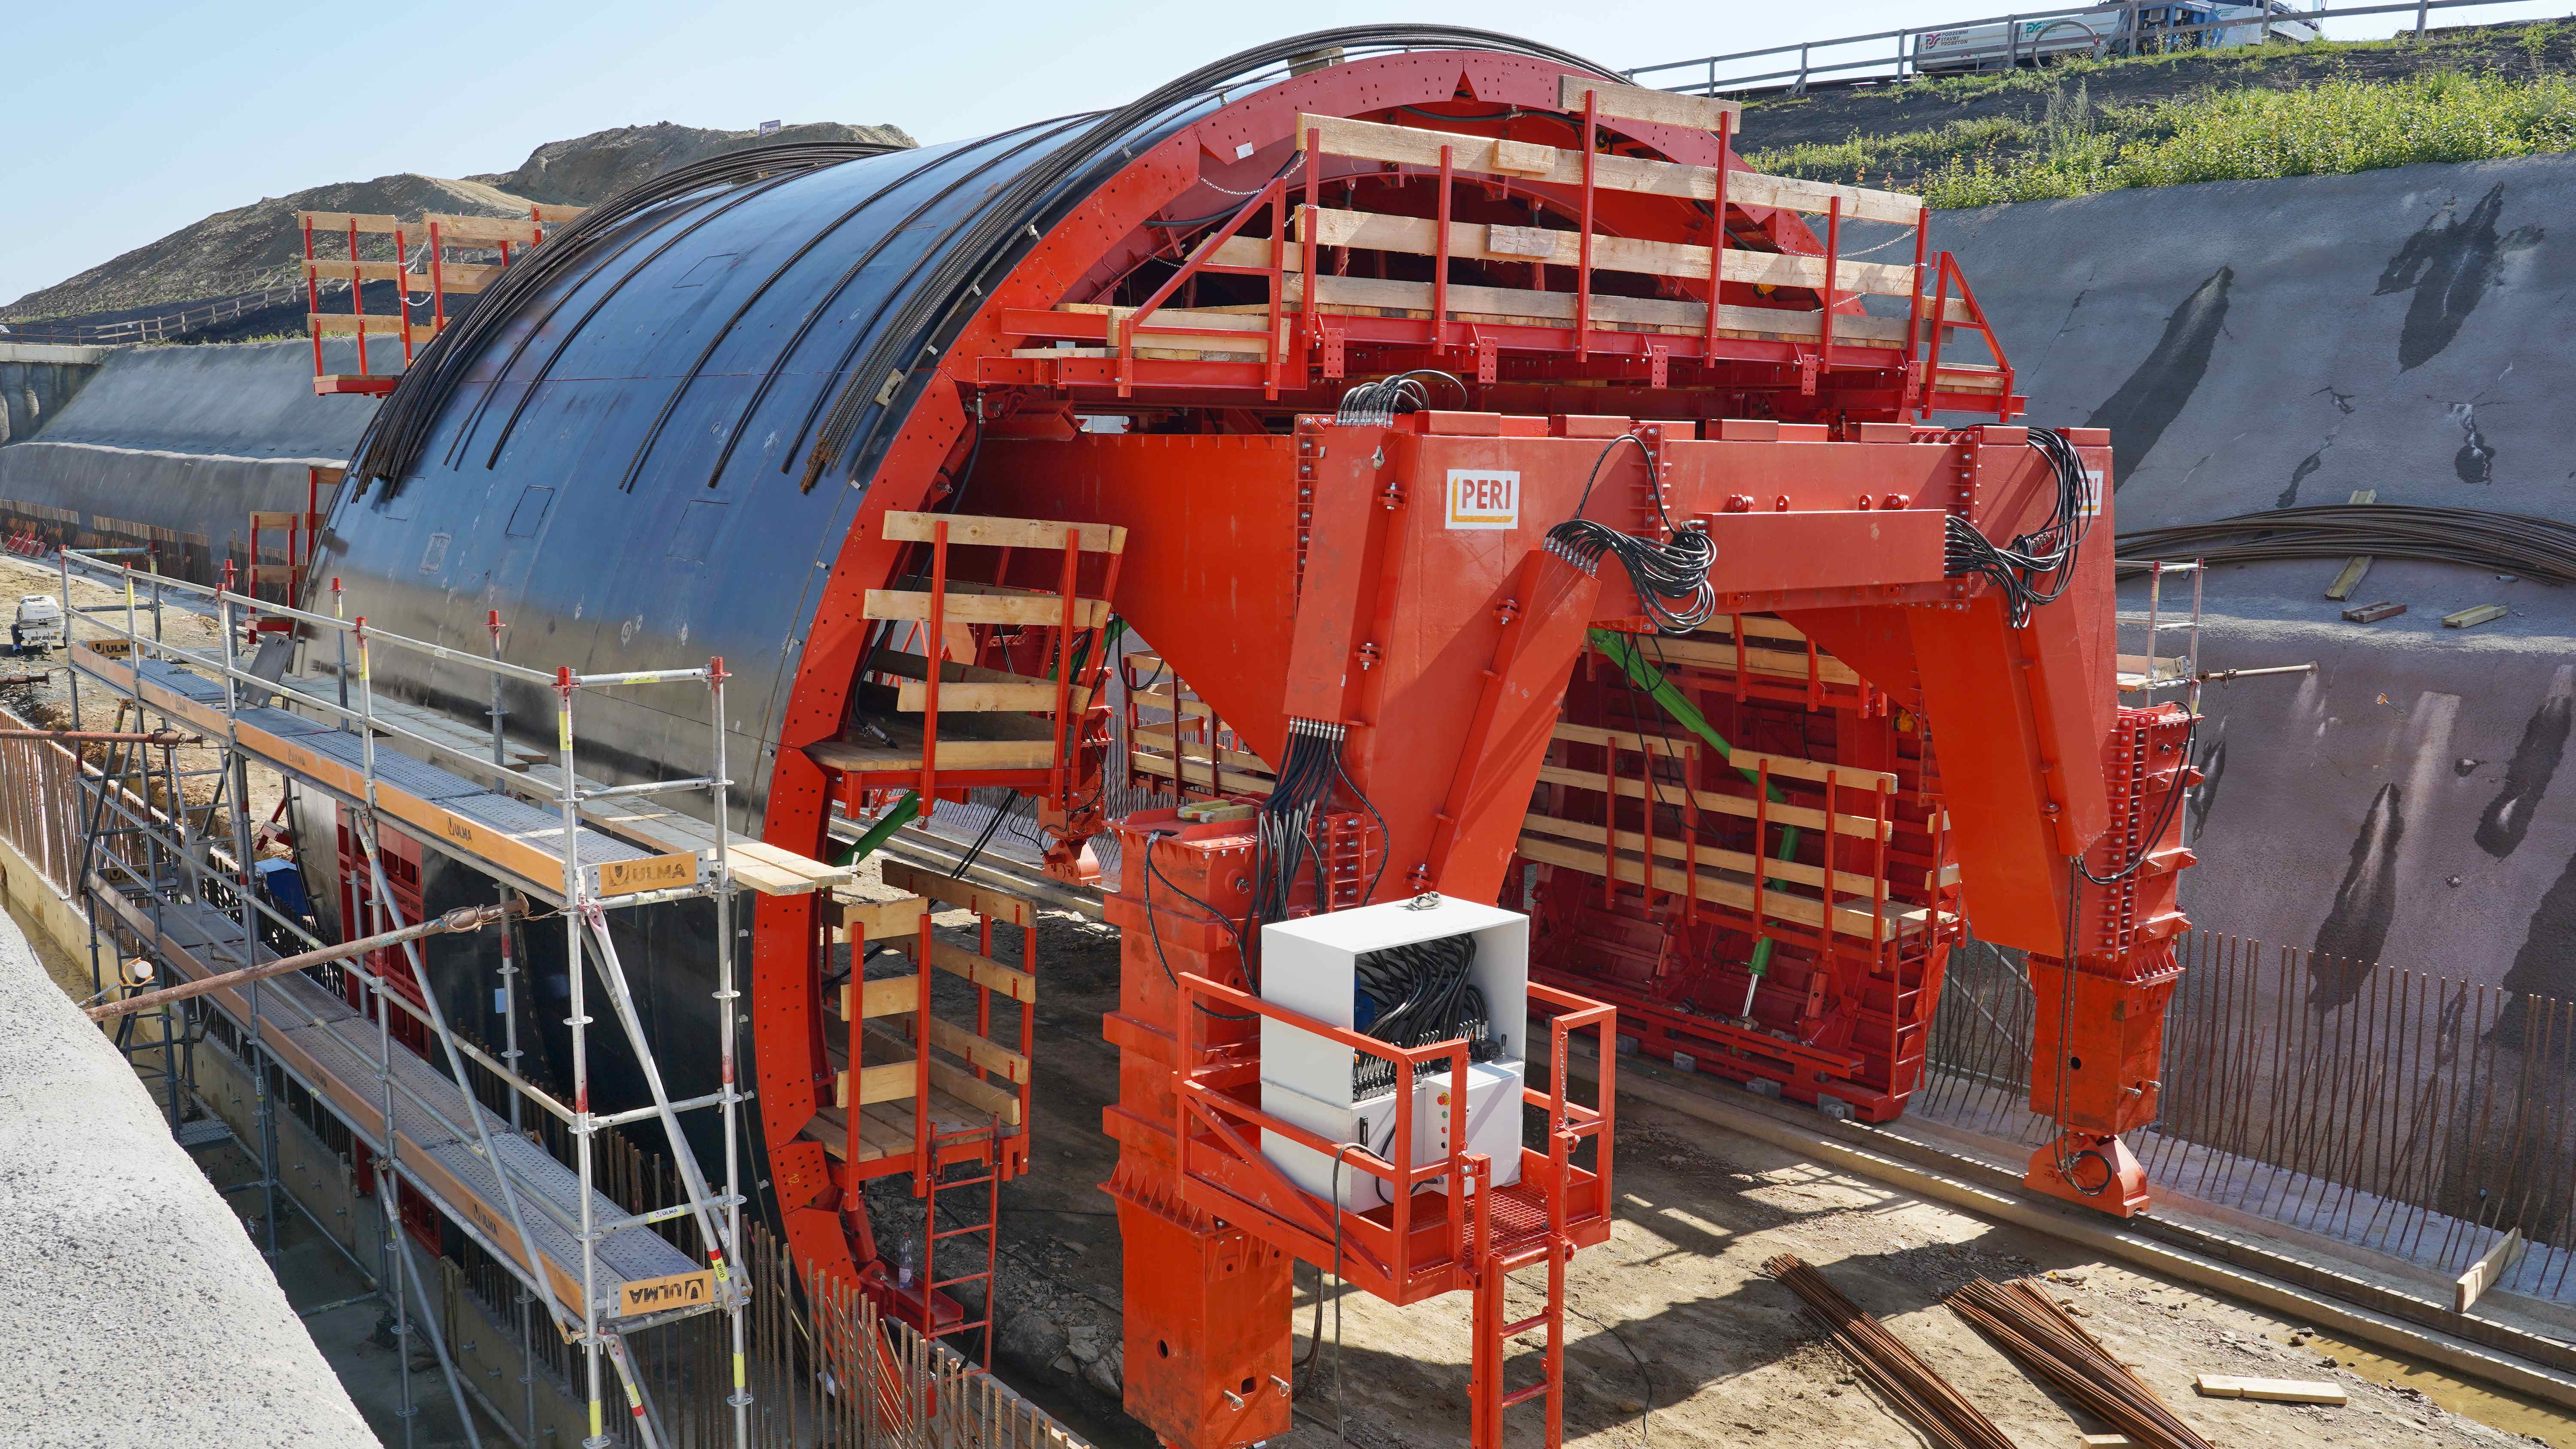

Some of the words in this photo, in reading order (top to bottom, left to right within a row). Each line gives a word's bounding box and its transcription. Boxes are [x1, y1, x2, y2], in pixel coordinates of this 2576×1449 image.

[1462, 479, 1512, 509] PERI
[2077, 478, 2098, 501] ERI
[106, 644, 131, 653] ULM
[454, 823, 472, 843] ULMA
[632, 863, 687, 881] ULMA
[716, 1263, 725, 1278] BRIO
[629, 1283, 682, 1305] ULMA
